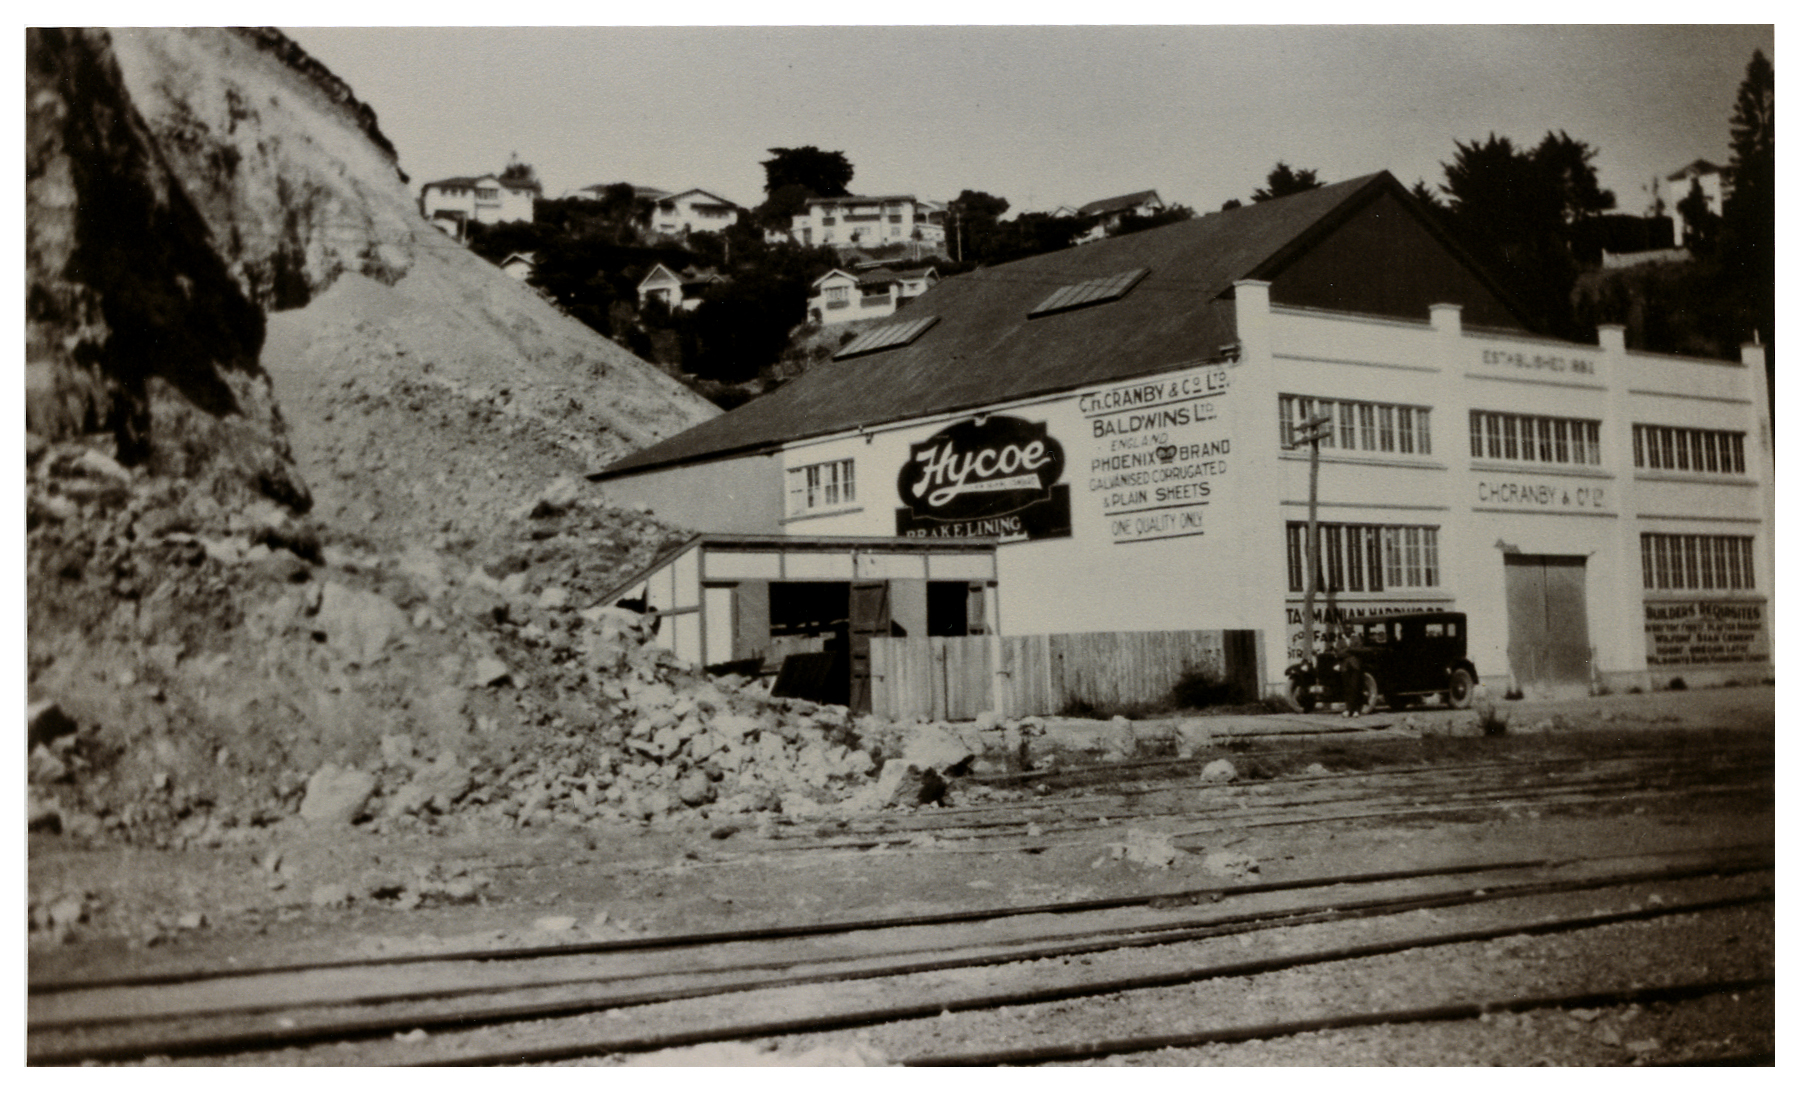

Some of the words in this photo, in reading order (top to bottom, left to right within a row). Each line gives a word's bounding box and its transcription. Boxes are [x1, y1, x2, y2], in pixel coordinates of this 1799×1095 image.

[1169, 382, 1179, 398] &
[1093, 408, 1190, 438] BALDWINS
[1111, 433, 1168, 451] ENGLAND
[1091, 451, 1155, 473] PHOENIX
[1179, 439, 1231, 461] BRAND
[912, 439, 1051, 507] Hycoe
[1089, 471, 1149, 491] GALVANISED
[1152, 460, 1227, 483] CORRUGATED
[1112, 490, 1148, 507] PLAIN
[1155, 482, 1211, 502] SHEETS
[1112, 519, 1131, 536] ONE
[1136, 514, 1176, 535] QUALITY
[1181, 511, 1204, 529] ONLY
